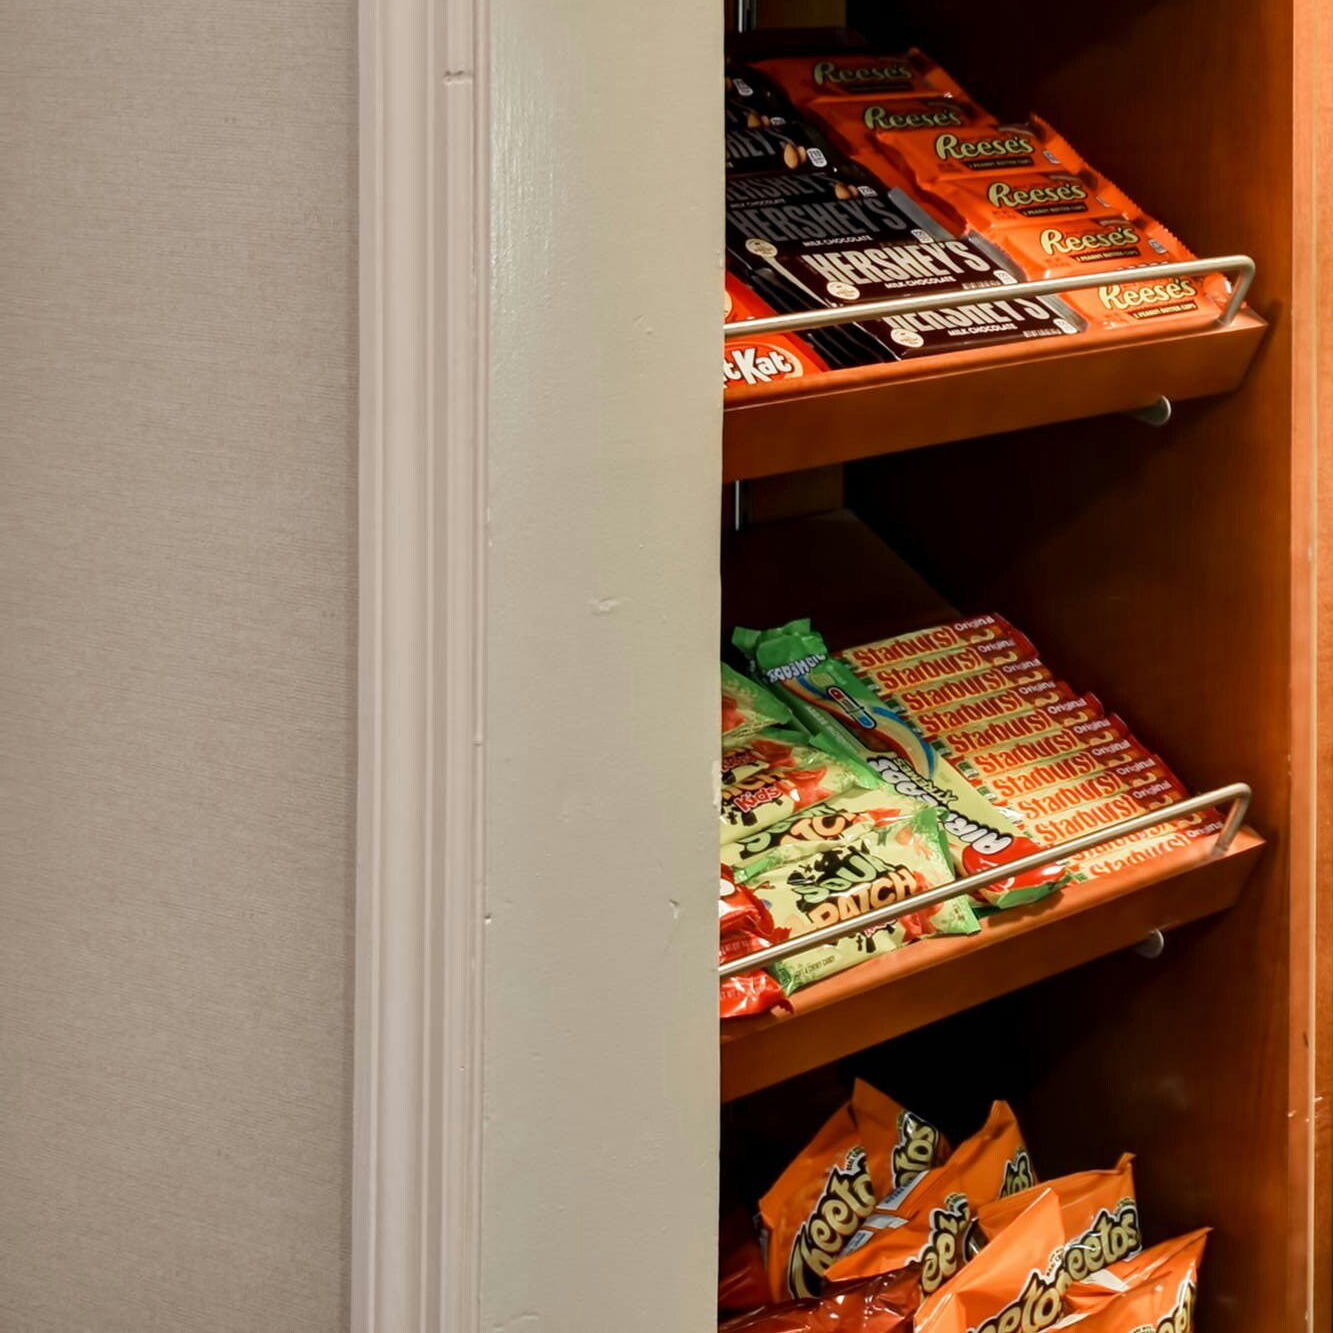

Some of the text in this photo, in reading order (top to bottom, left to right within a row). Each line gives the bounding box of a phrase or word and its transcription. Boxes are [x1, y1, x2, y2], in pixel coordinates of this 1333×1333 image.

[813, 61, 913, 86] Reese's
[863, 105, 963, 131] Reese's
[935, 133, 1035, 160] Reese's
[987, 182, 1087, 209] Reese's
[727, 198, 908, 243] HERSHEY'S
[802, 234, 873, 247] MILK CHOCOLATE
[1039, 227, 1140, 256] Reese's
[802, 239, 991, 286] HERSHEY'S
[884, 275, 957, 289] MILK CHOCOLATE
[1097, 277, 1198, 310] Reese's
[947, 322, 1018, 337] MILK CHOCOLATE
[733, 786, 783, 813] Kids
